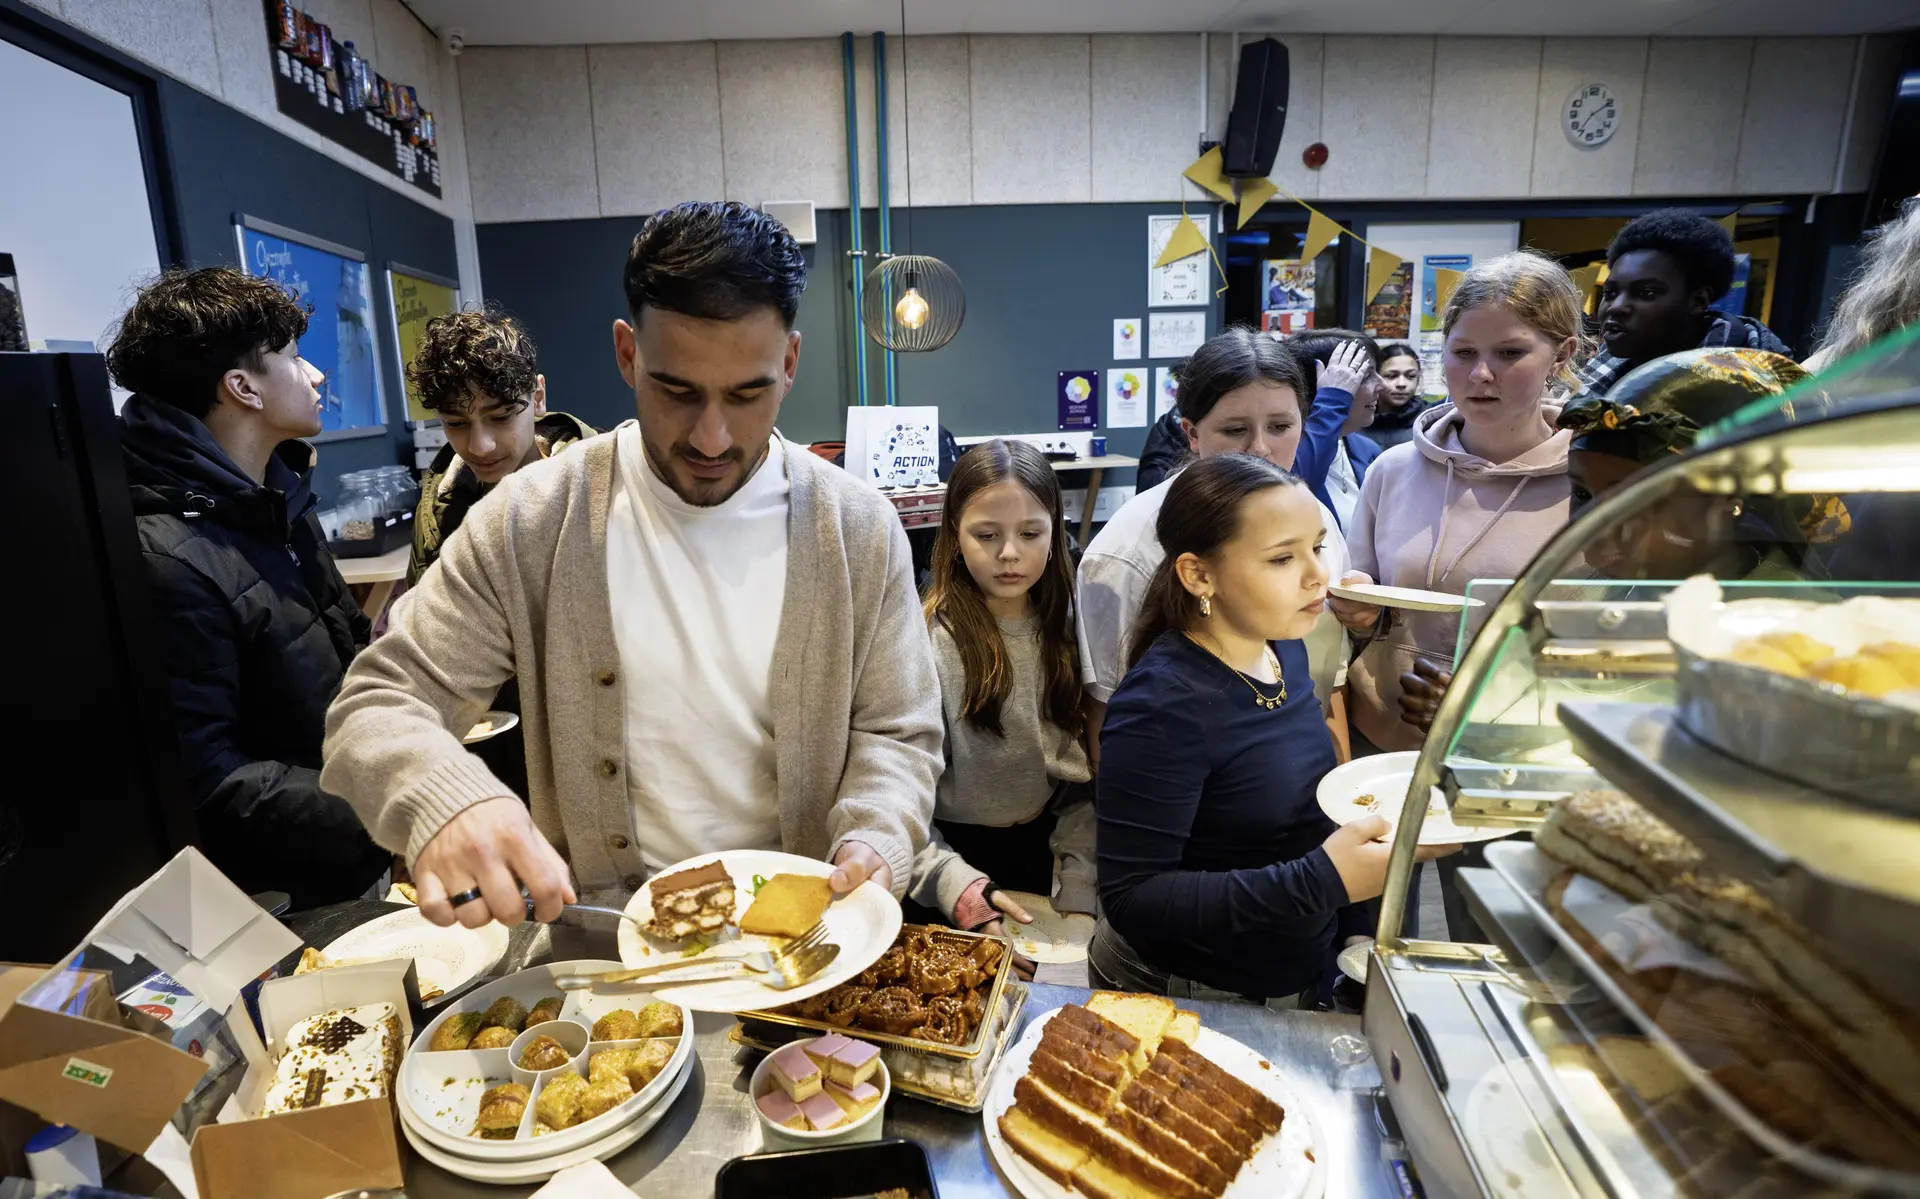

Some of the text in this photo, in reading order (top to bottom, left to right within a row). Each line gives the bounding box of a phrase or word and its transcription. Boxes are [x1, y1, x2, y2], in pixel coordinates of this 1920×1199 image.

[1605, 98, 1614, 107] 2
[1569, 110, 1578, 119] 9
[1607, 109, 1616, 118] 3
[1571, 121, 1579, 130] 8
[1603, 120, 1611, 129] 4
[1577, 128, 1585, 138] 7
[1585, 132, 1594, 141] 6
[1595, 128, 1604, 138] 5
[893, 456, 935, 467] ACTION
